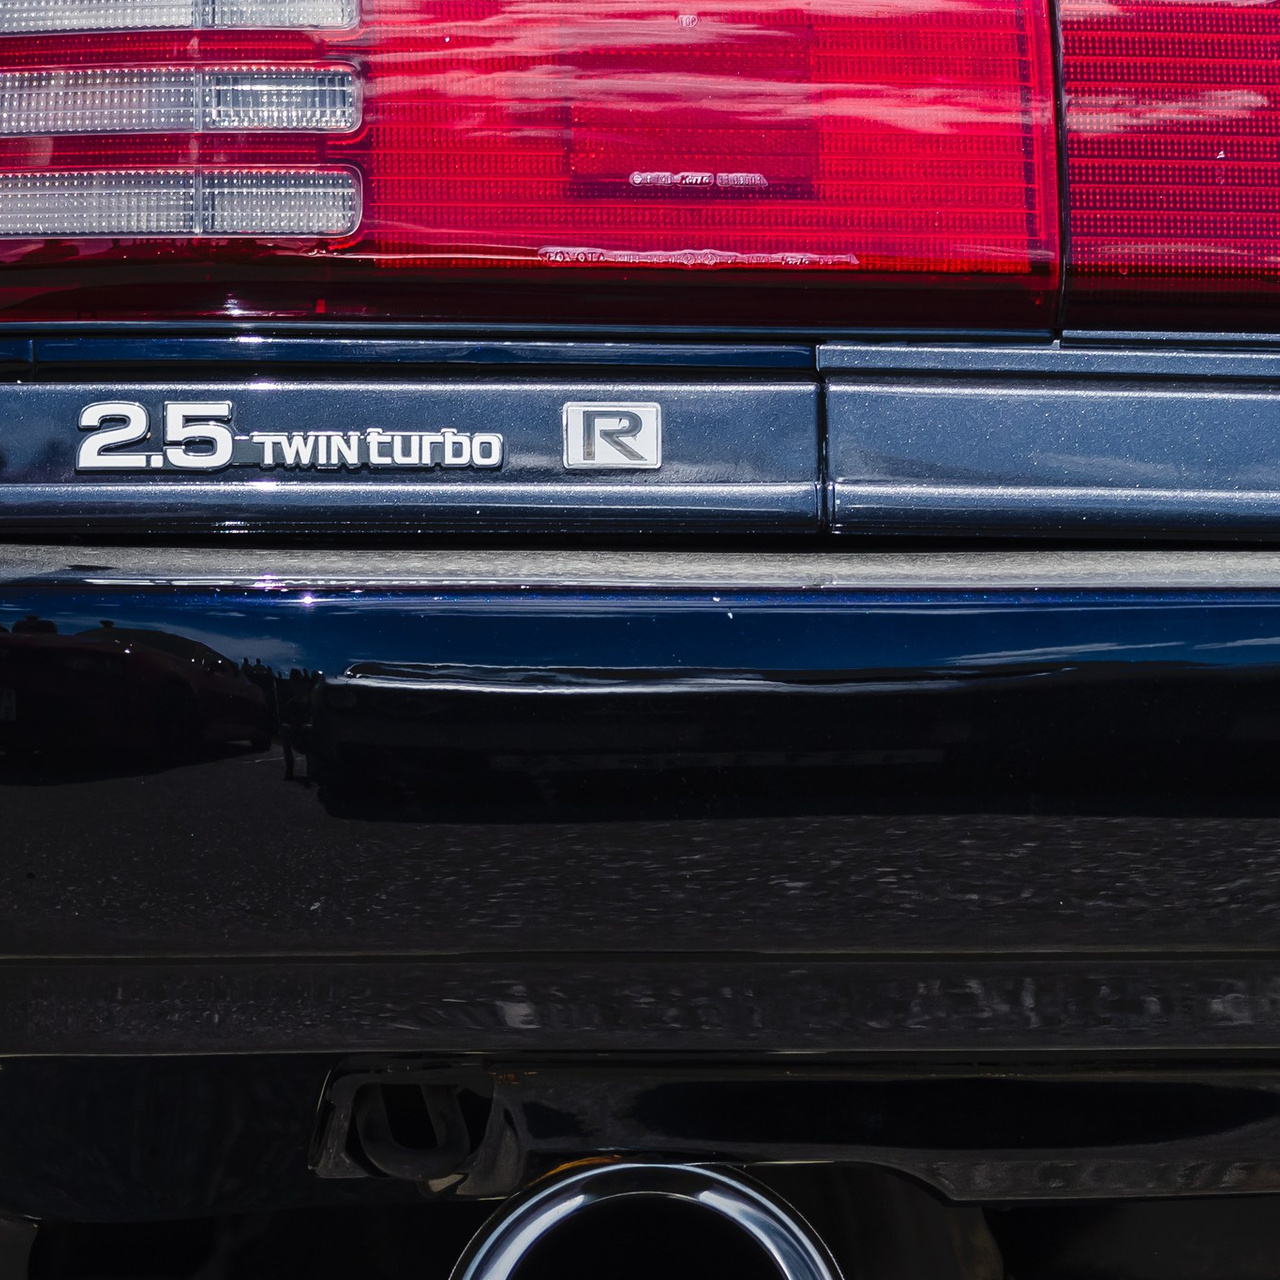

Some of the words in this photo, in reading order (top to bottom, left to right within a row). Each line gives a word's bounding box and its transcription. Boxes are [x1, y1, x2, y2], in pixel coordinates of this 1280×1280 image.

[544, 250, 607, 262] TOYOTA
[77, 401, 233, 469] 2.5
[252, 434, 359, 466] TWIN
[368, 429, 503, 467] turbo
[582, 410, 648, 462] R
